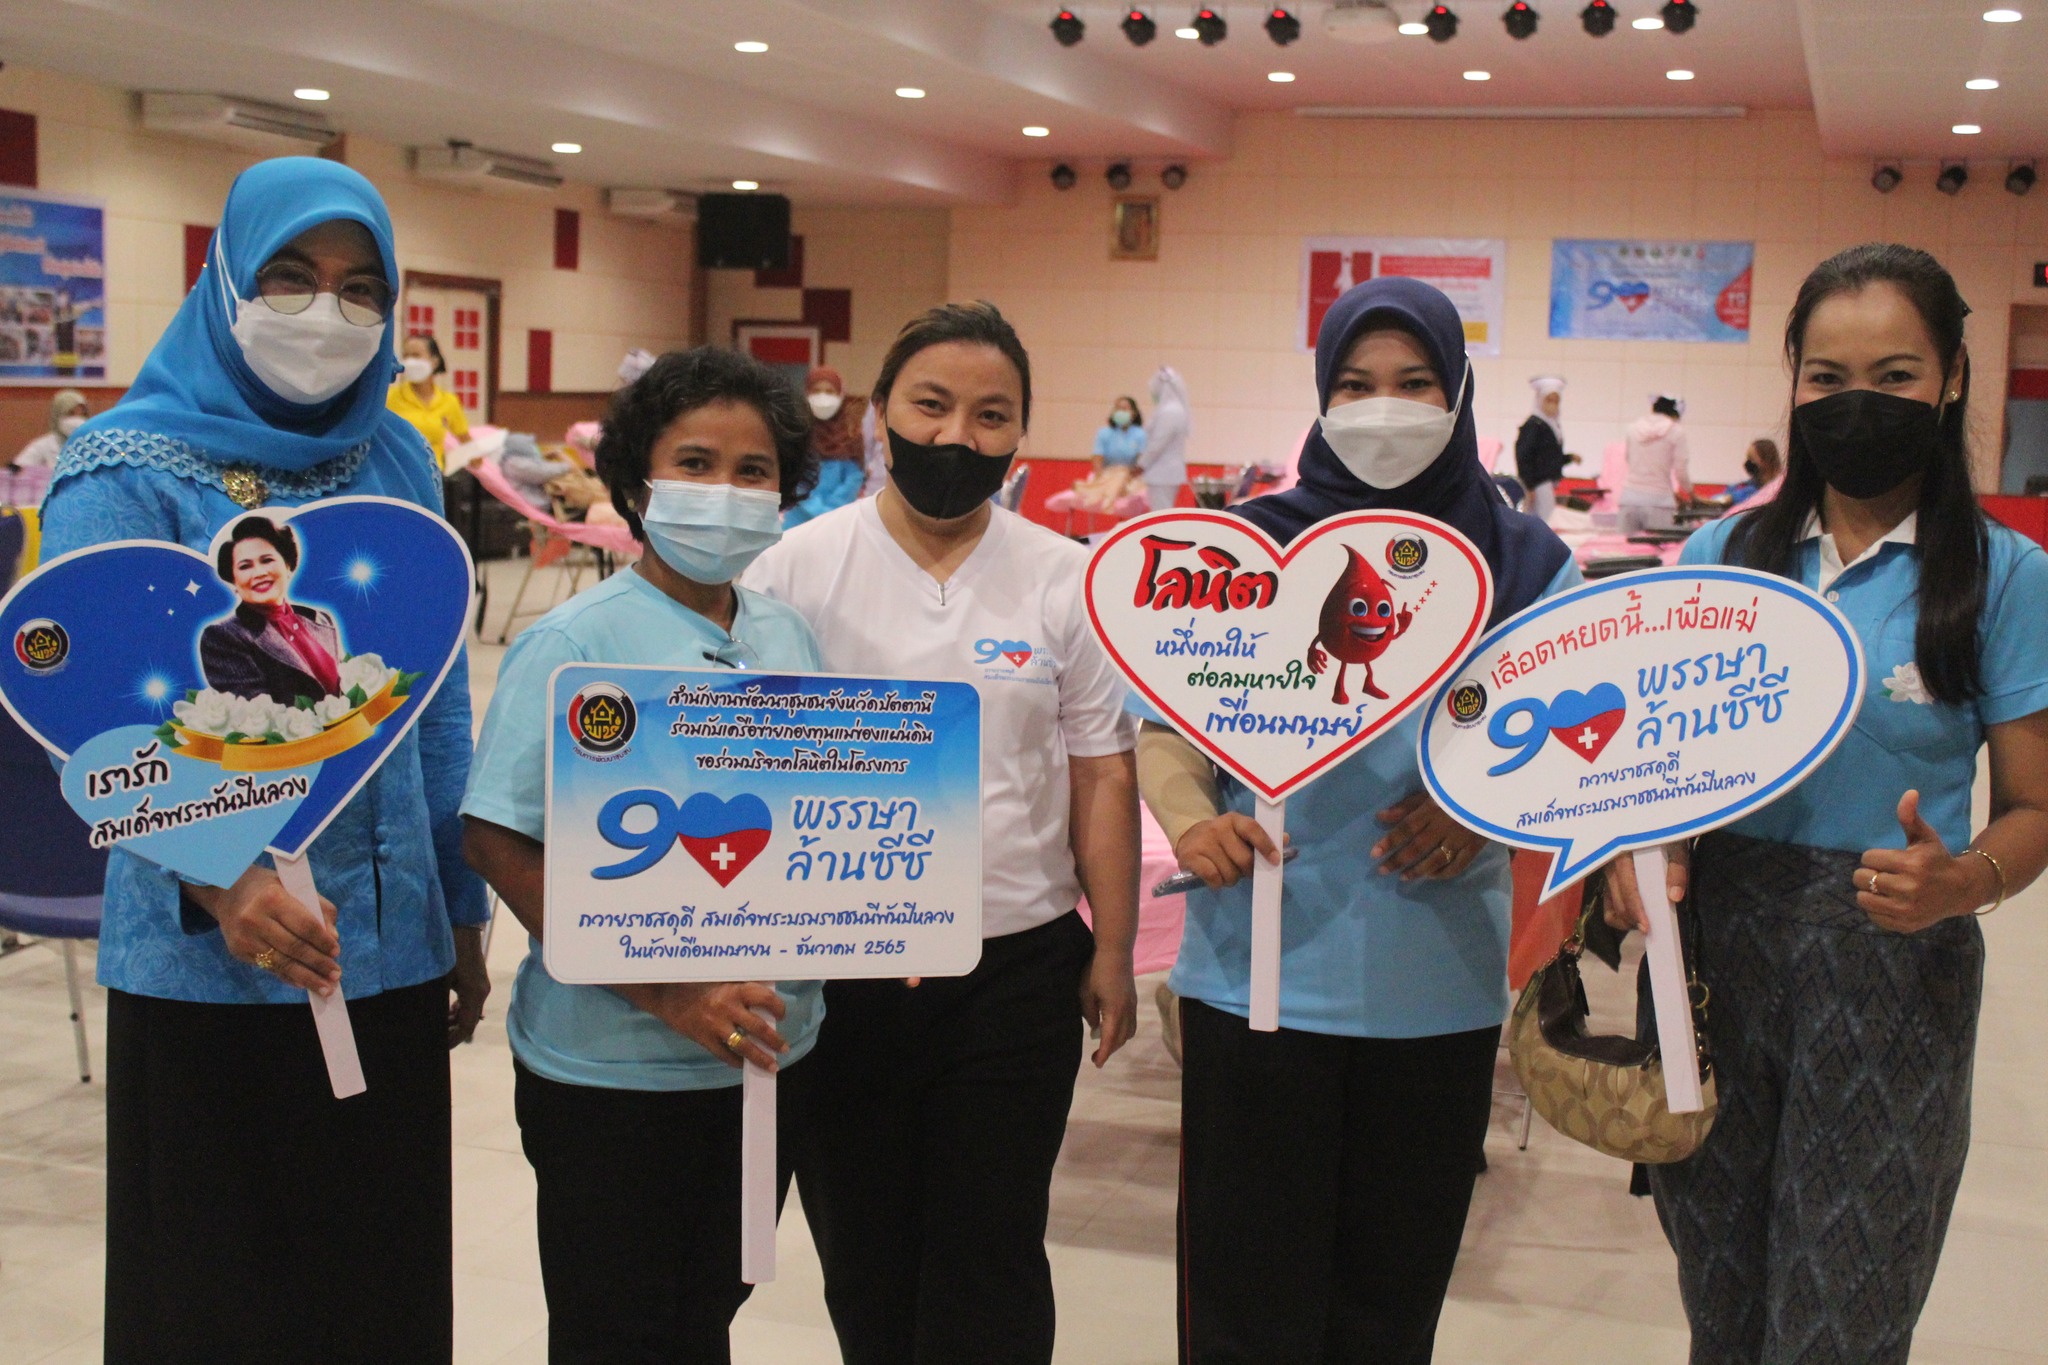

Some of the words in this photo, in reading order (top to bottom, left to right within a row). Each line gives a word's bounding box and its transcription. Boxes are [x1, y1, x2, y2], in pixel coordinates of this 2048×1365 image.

[1134, 535, 1278, 612] โลหิต
[1156, 617, 1268, 657] หนึ่งคนให้
[1187, 659, 1316, 690] ต่อลมหายใจ
[1637, 643, 1767, 699] พรรษา
[1205, 689, 1368, 750] เพื่อนมนุษย์
[1636, 666, 1789, 750] ล้านซีซี
[89, 742, 168, 797] เรารัก
[696, 748, 909, 773] ขอร่วมบริจาคโลหิตในโครงการ
[94, 776, 307, 845] สมเด็จพระพันปีหลวง
[794, 800, 918, 832] พรรษา
[786, 829, 935, 882] ล้านซีซี
[796, 935, 856, 956] ธันวาคม
[864, 940, 906, 955] 2565
